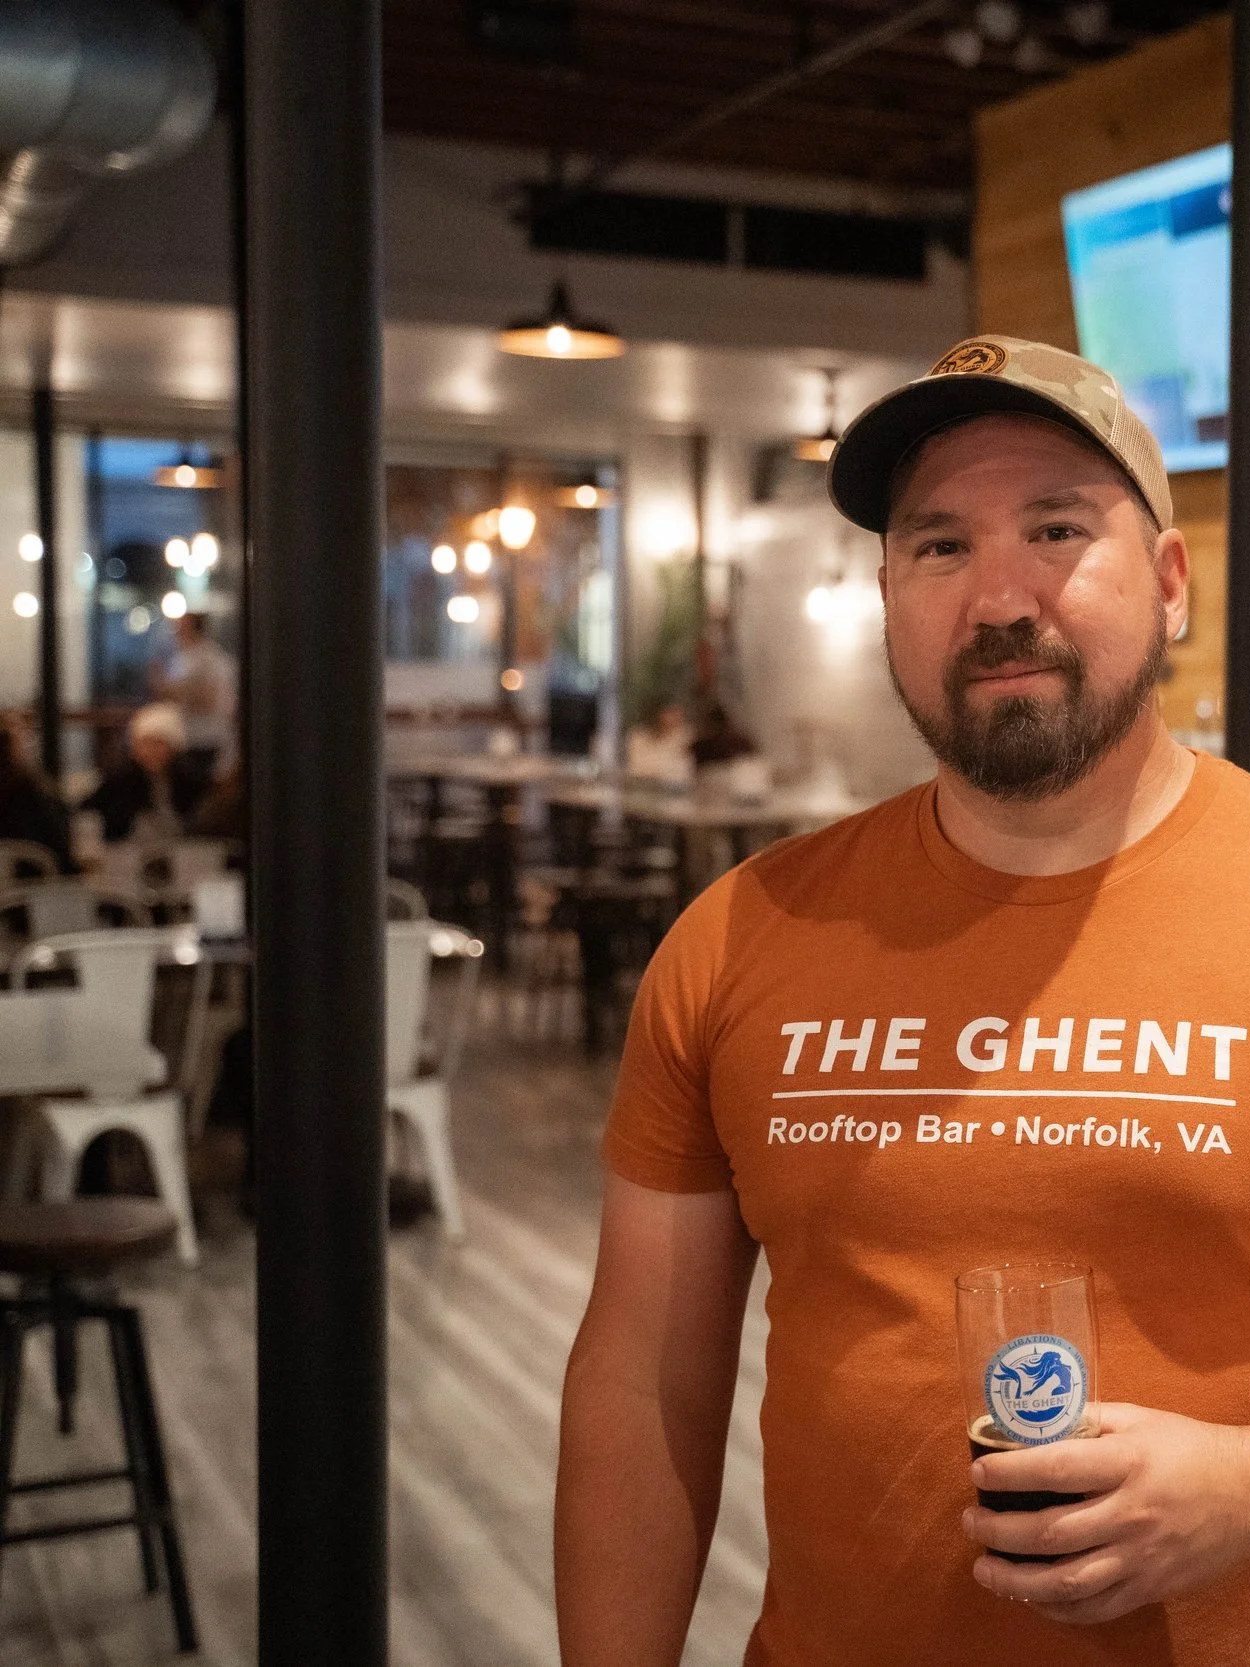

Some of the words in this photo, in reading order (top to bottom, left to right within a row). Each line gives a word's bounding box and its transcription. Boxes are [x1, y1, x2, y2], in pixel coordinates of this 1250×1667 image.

[781, 1018, 927, 1075] THE
[956, 1016, 1248, 1081] GHENT
[767, 1114, 901, 1149] Rooftop
[916, 1114, 981, 1143] Bar
[1015, 1116, 1161, 1154] Norfolk,
[1177, 1122, 1232, 1154] VA
[1007, 1336, 1063, 1350] LIBATIONS
[1006, 1400, 1028, 1409] THE
[1032, 1396, 1069, 1408] GHENT
